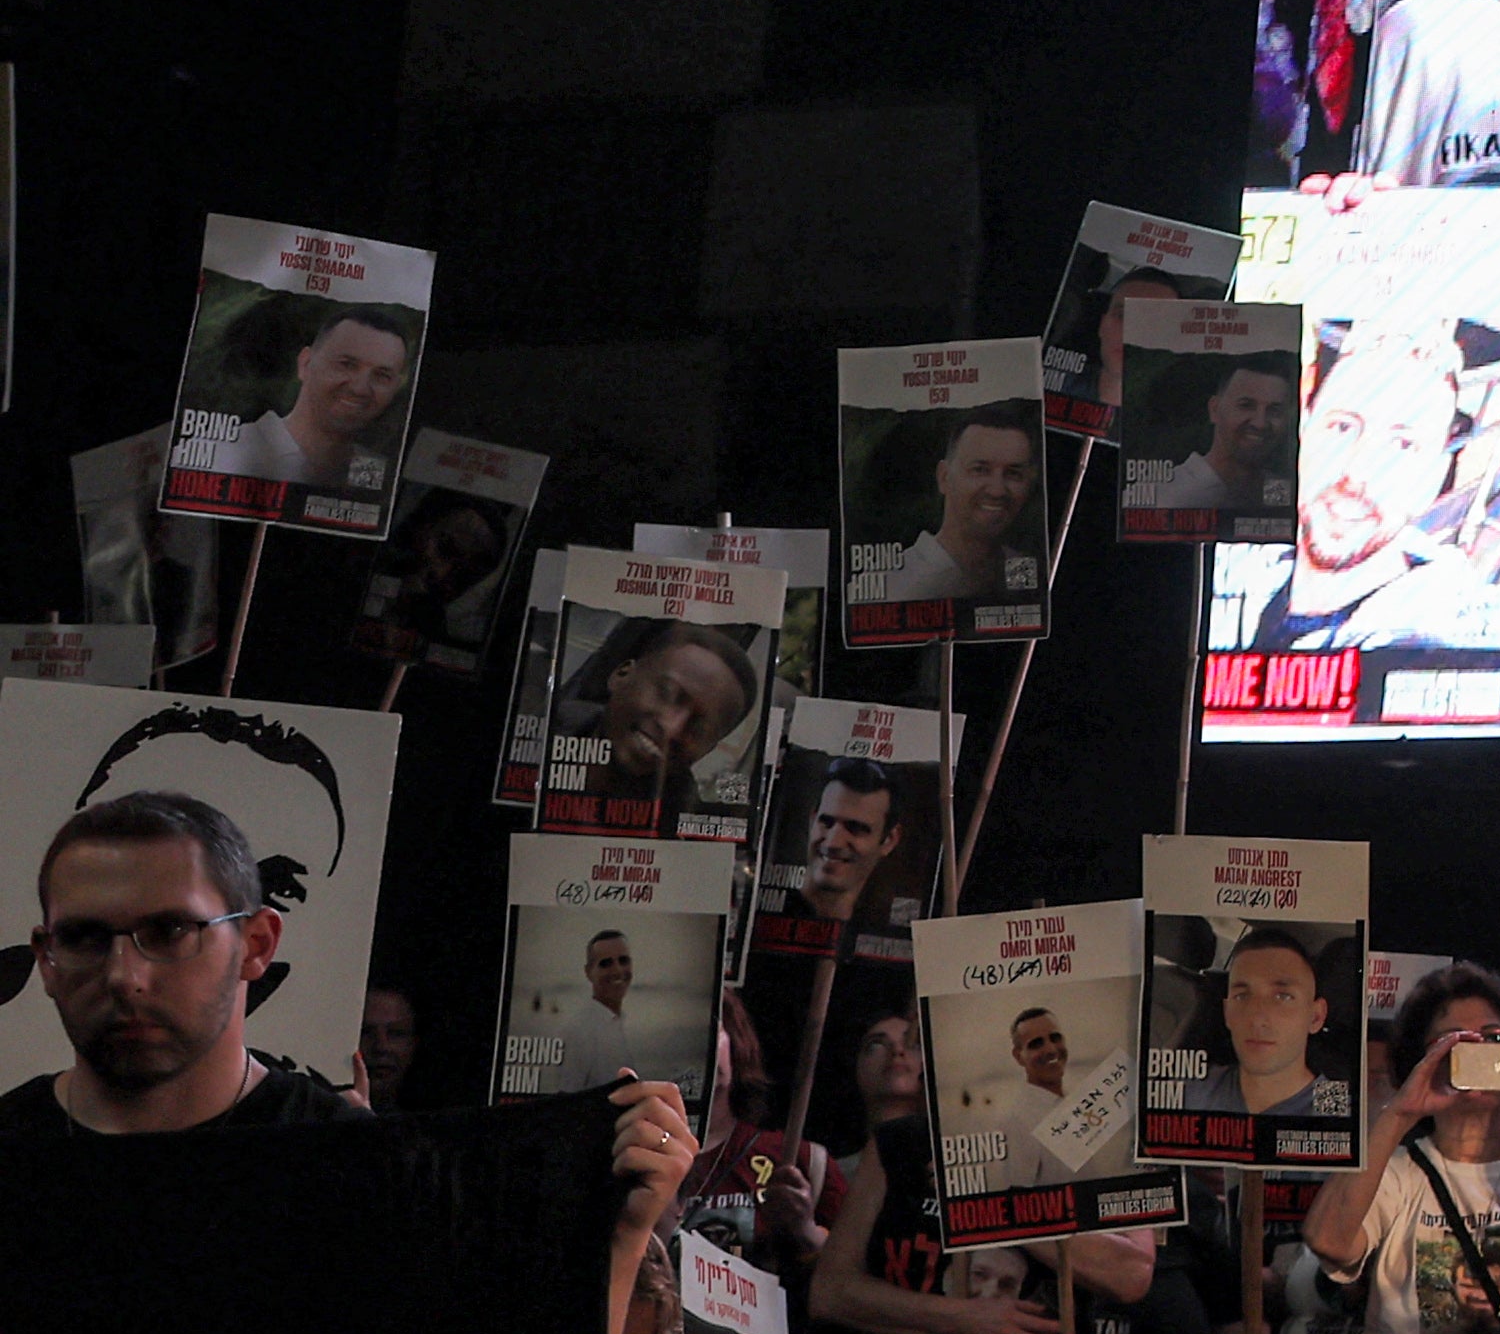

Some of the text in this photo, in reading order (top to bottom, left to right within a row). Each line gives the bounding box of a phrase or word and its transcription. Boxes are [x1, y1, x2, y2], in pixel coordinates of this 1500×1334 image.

[279, 250, 366, 282] YOSSI SHARABI
[615, 576, 735, 606] JOSHUA LOITU MOLLEL
[1214, 866, 1301, 887] MATAN ANGREST
[1000, 933, 1075, 959] OMRI MIRAN
[1148, 1047, 1208, 1079] BRING
[1147, 1078, 1184, 1110] HIM
[1145, 1114, 1254, 1149] HOME NOW!
[941, 1131, 1008, 1166] BRING
[944, 1165, 988, 1196] HIM
[948, 1185, 1075, 1232] HOME NOW!
